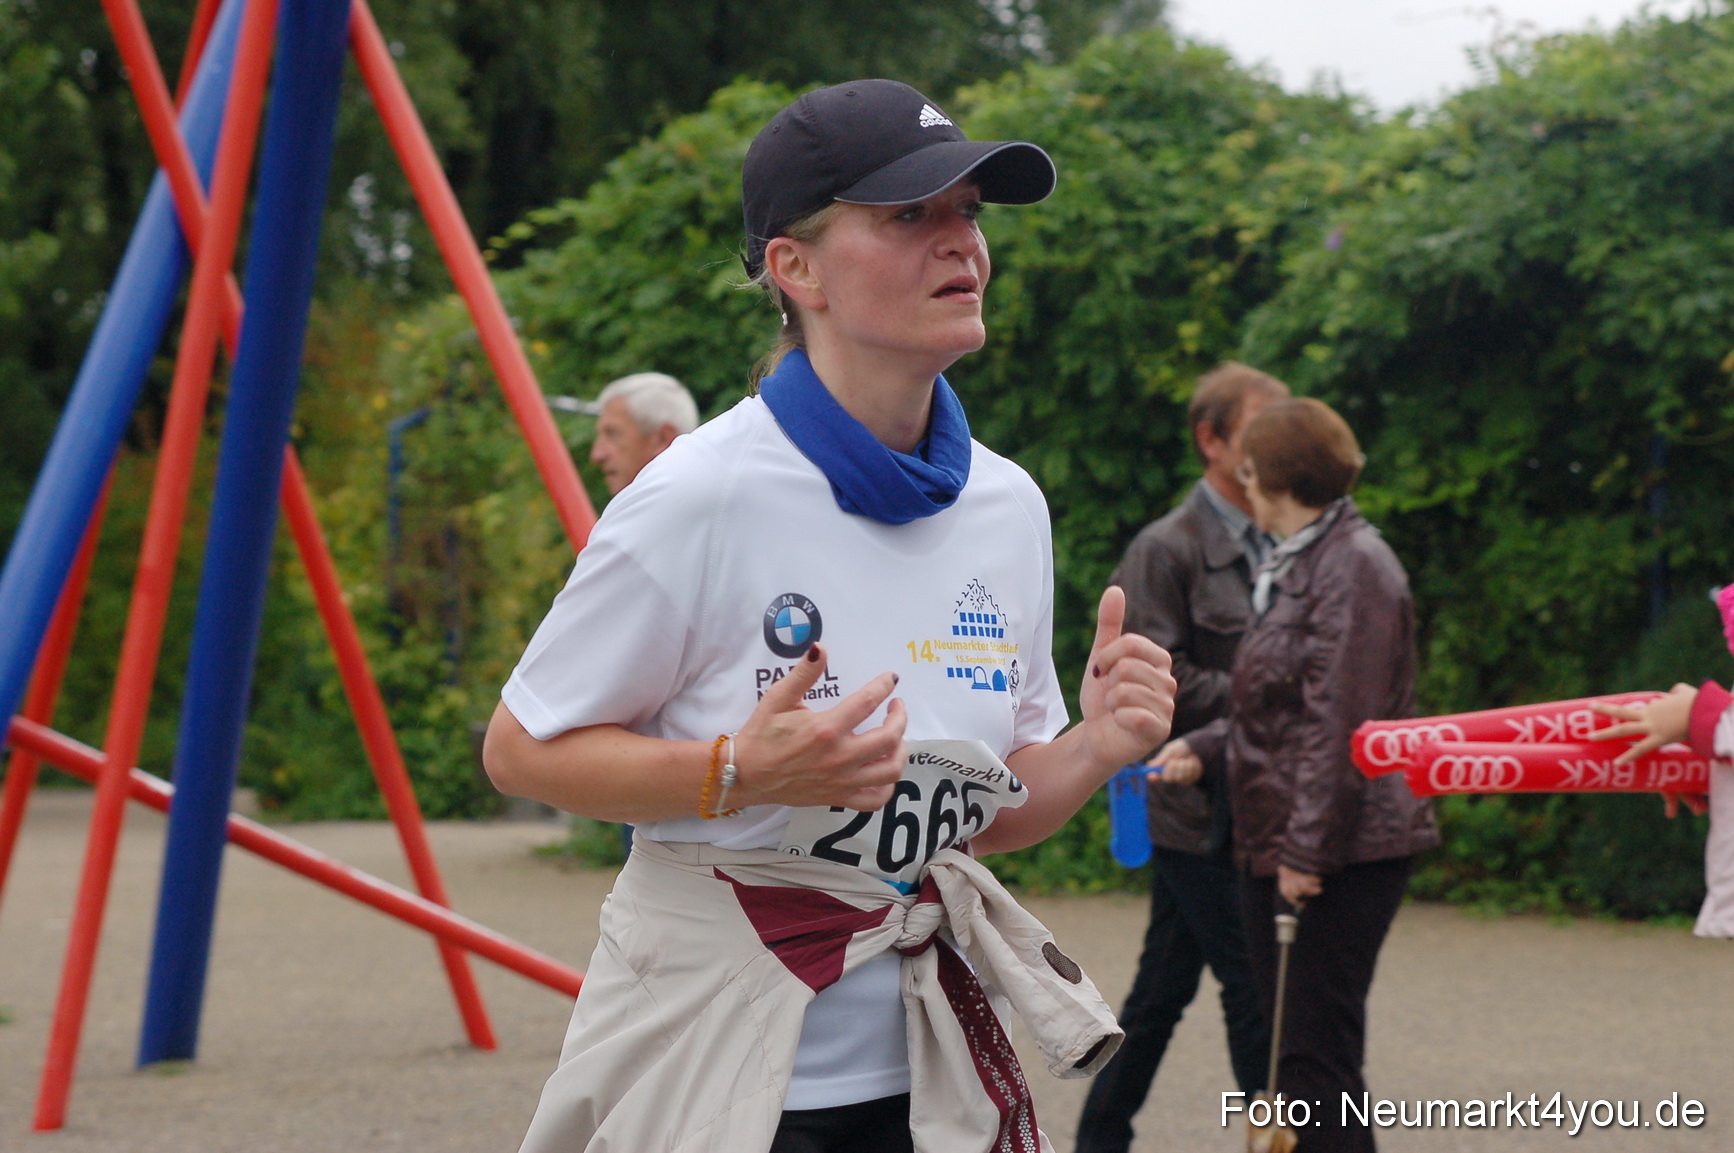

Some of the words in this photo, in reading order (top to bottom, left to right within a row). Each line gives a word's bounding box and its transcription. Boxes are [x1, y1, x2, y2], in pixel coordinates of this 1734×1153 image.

[767, 595, 815, 618] BMW
[906, 640, 941, 663] 14.
[933, 639, 988, 651] Neumarkter
[755, 663, 838, 689] PAL
[756, 683, 840, 703] Narkt
[1505, 710, 1596, 743] BKK
[1558, 759, 1634, 788] BKK
[1646, 760, 1707, 787] udi
[810, 778, 998, 873] 2665
